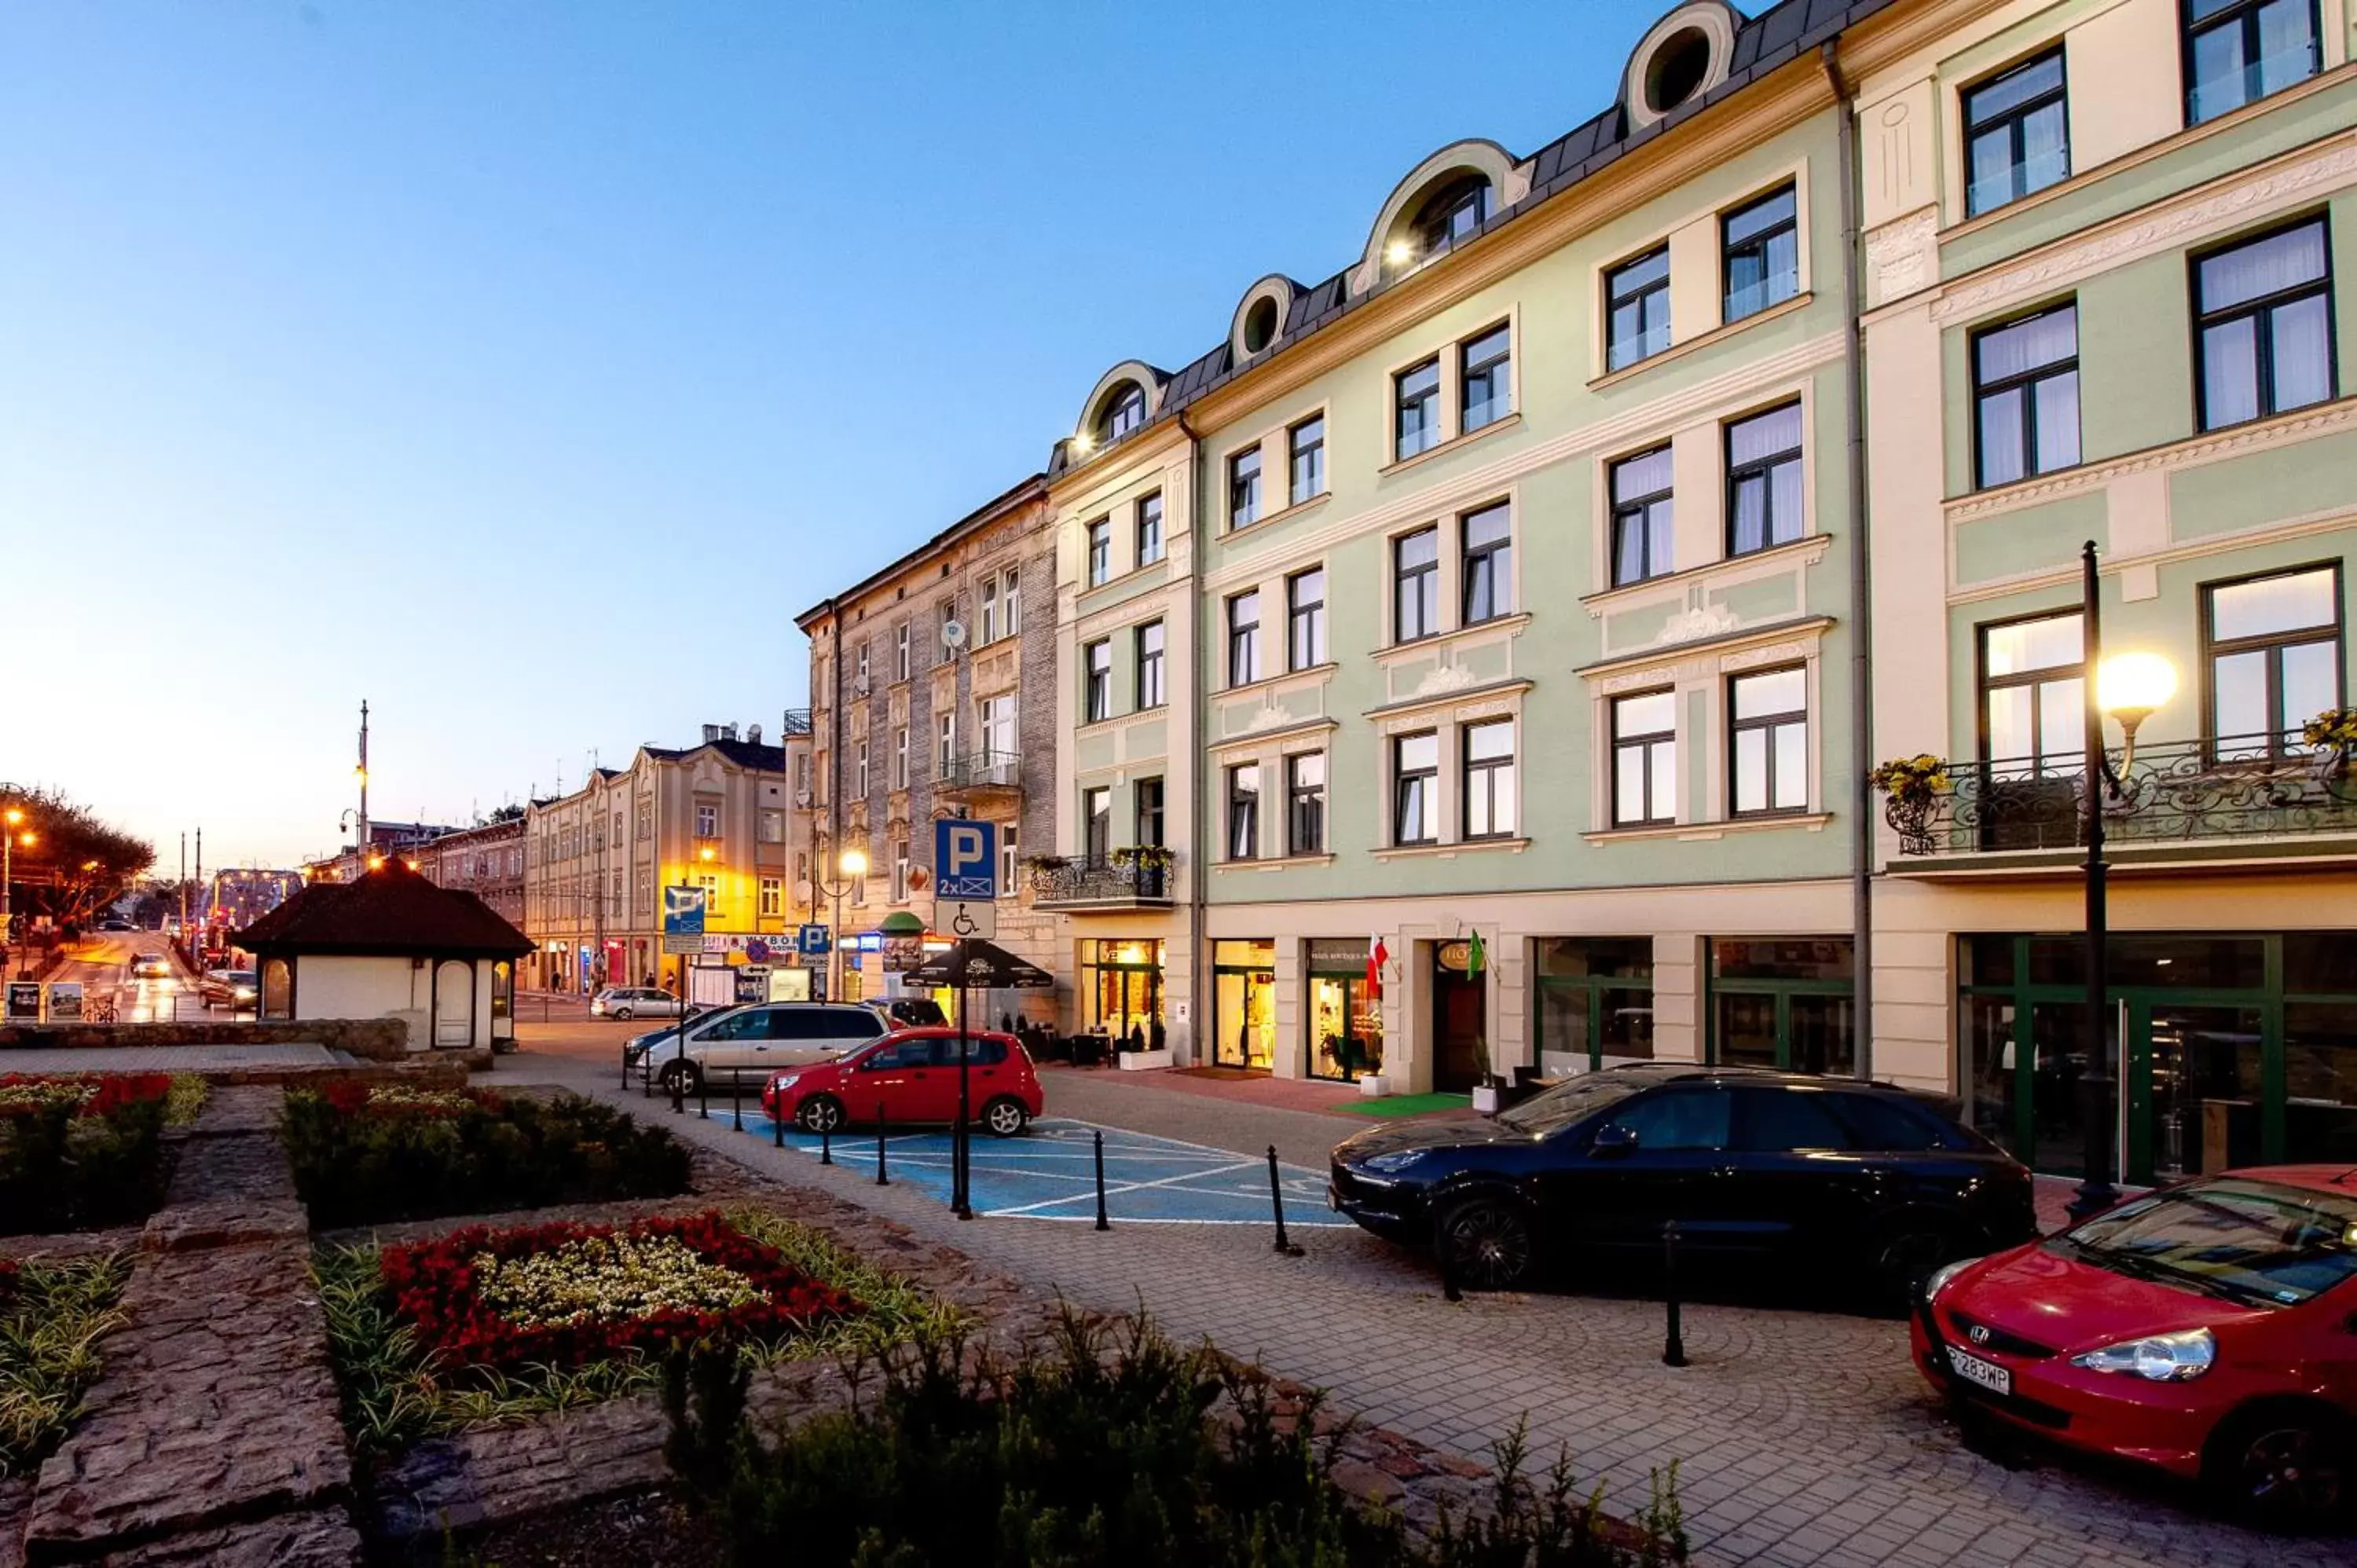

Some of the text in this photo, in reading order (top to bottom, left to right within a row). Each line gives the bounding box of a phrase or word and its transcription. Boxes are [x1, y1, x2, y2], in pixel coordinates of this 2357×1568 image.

[950, 827, 984, 876] P
[940, 879, 959, 894] 2x
[674, 892, 696, 919] P
[806, 927, 823, 950] P
[1960, 1355, 2007, 1387] 283WP
